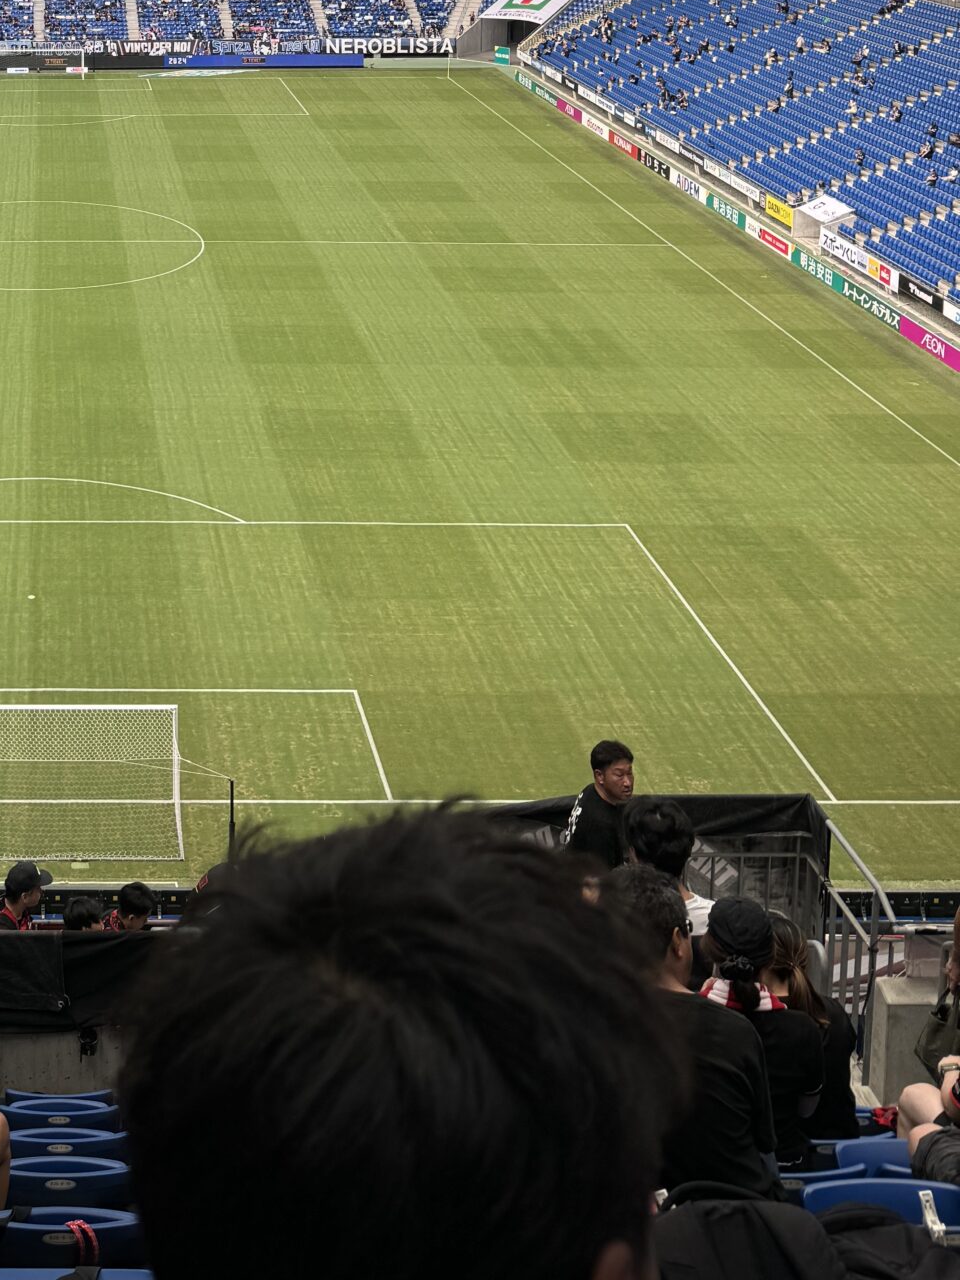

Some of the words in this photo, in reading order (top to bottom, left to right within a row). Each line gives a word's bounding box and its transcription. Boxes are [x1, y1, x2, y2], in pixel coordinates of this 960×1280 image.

[325, 38, 454, 54] NEROBLISTA
[613, 133, 632, 154] KONAMI
[676, 173, 700, 199] AIDEM
[713, 196, 739, 225] 明治安田
[823, 234, 856, 264] スポーツくじ
[800, 251, 833, 287] 明治安田
